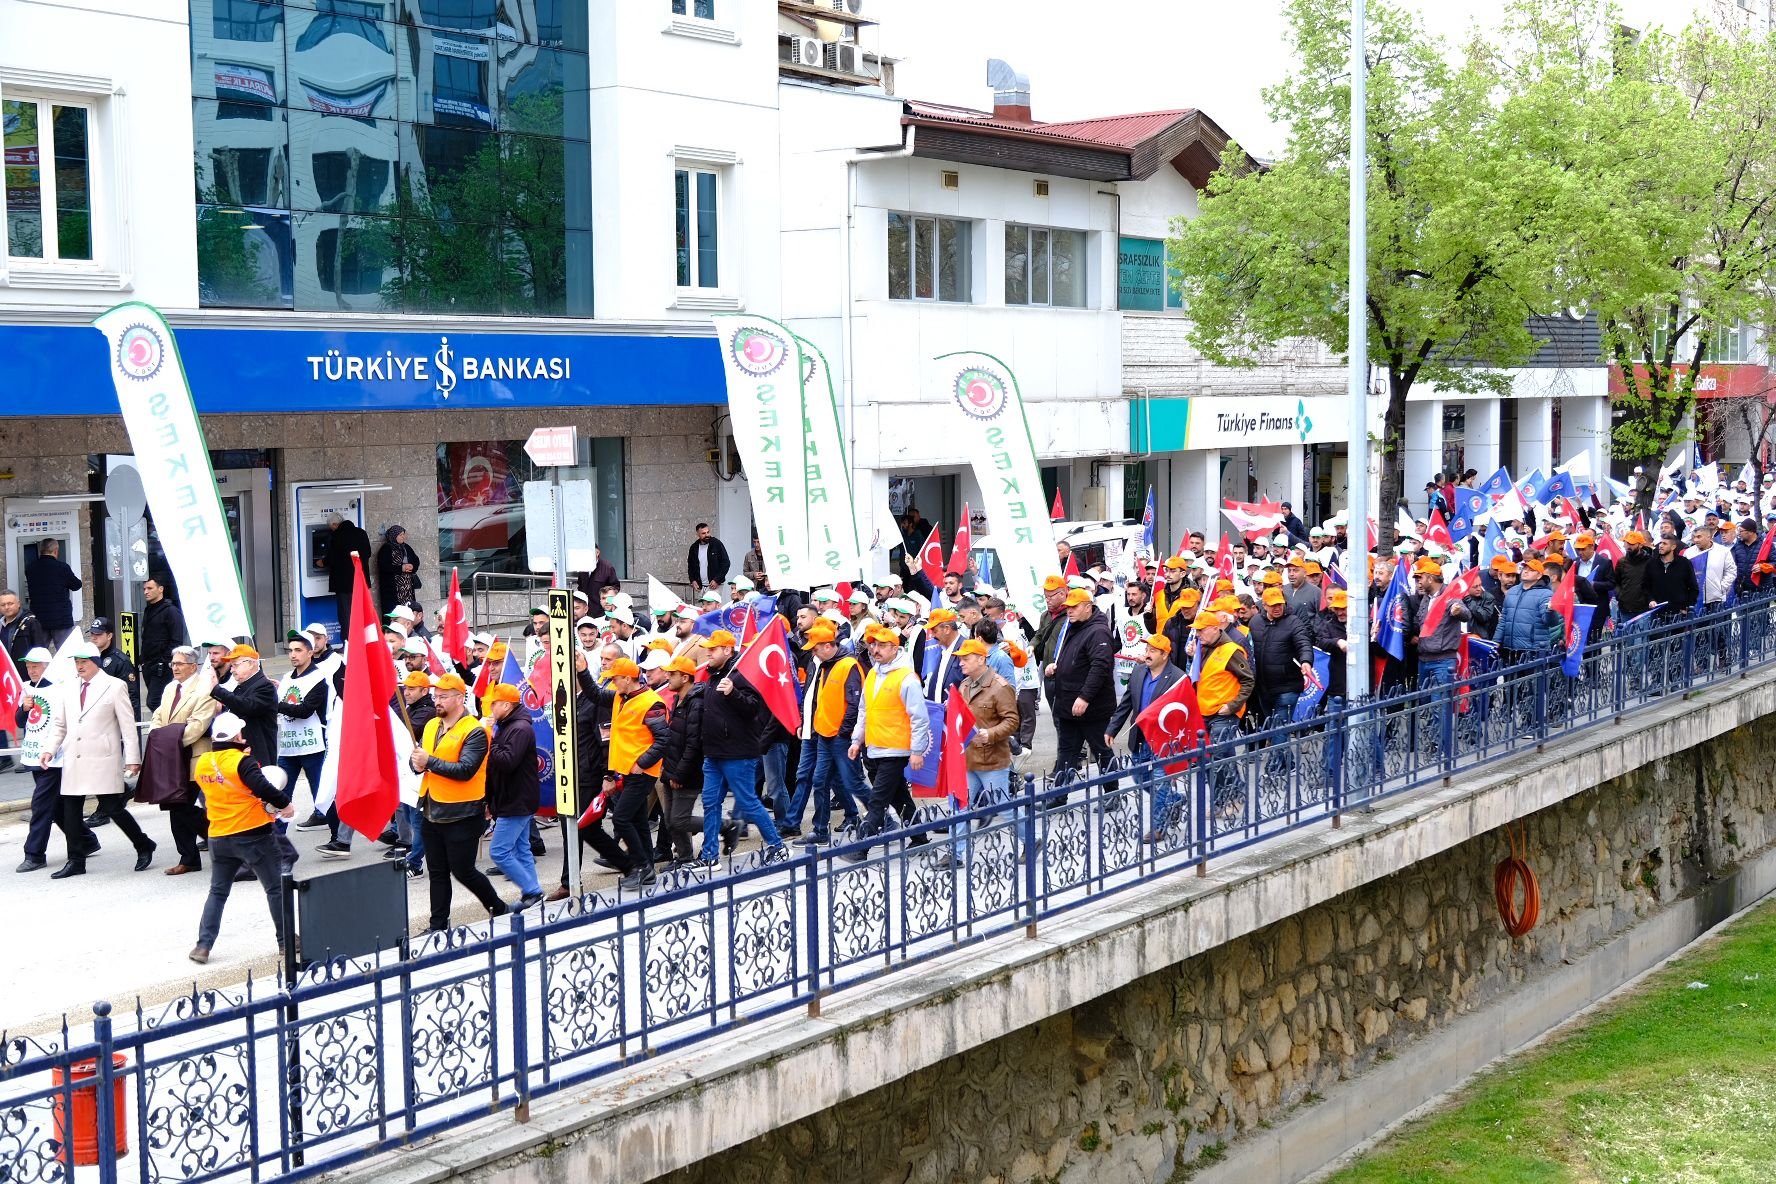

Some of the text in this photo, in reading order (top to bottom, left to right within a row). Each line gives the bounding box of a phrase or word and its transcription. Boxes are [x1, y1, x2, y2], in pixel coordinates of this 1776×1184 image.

[1119, 253, 1160, 267] SRAFSIZLIK
[307, 349, 429, 381] TÜRKİYE
[463, 357, 571, 380] BANKASI
[1217, 412, 1293, 436] Türkiye Finans
